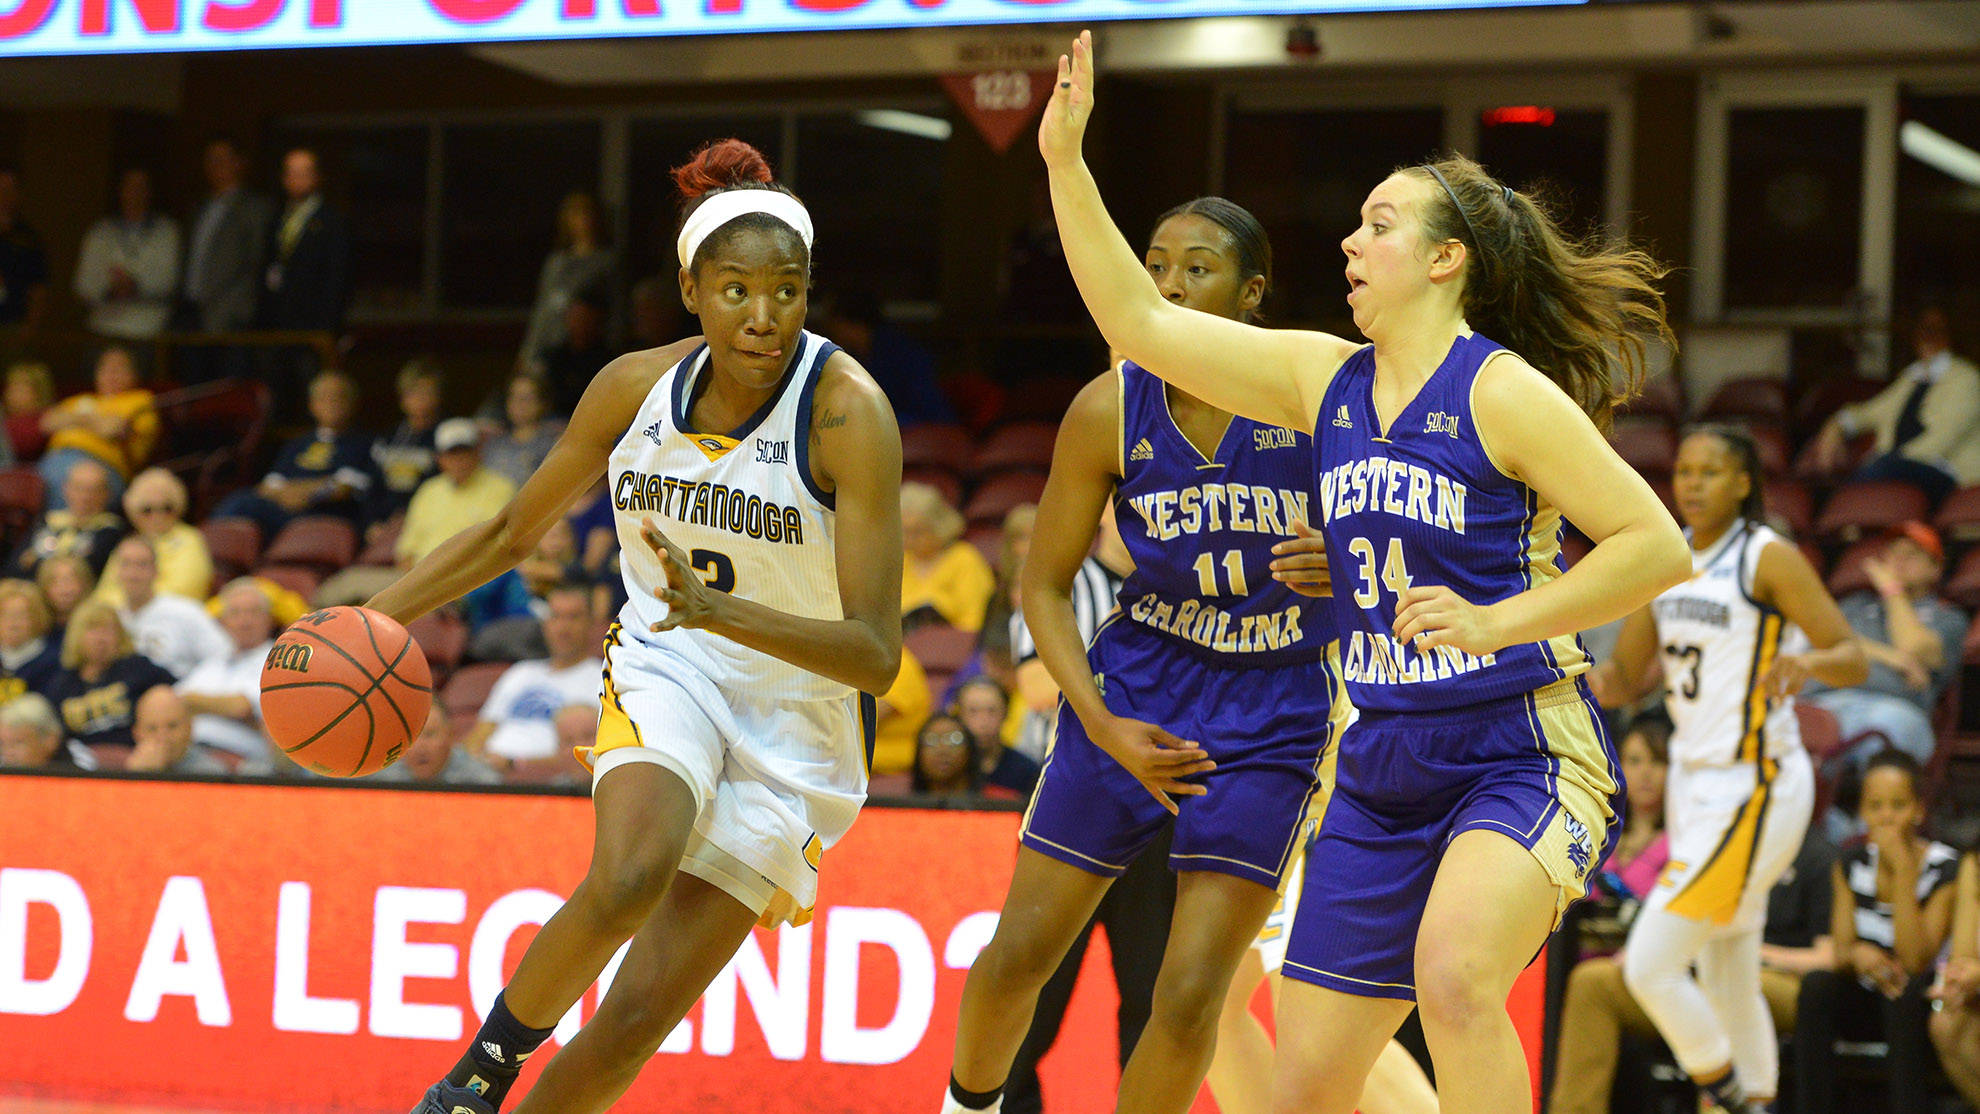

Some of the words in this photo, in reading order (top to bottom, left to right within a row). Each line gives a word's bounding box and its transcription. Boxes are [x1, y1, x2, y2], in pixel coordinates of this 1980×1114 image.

[615, 470, 803, 545] CHATTANOOGA
[1129, 483, 1309, 541] WESTERN
[1319, 456, 1467, 535] WESTERN
[1193, 549, 1249, 597] 11
[1348, 537, 1413, 609] 34
[1131, 593, 1304, 653] CAROLINA
[124, 875, 233, 1027] A
